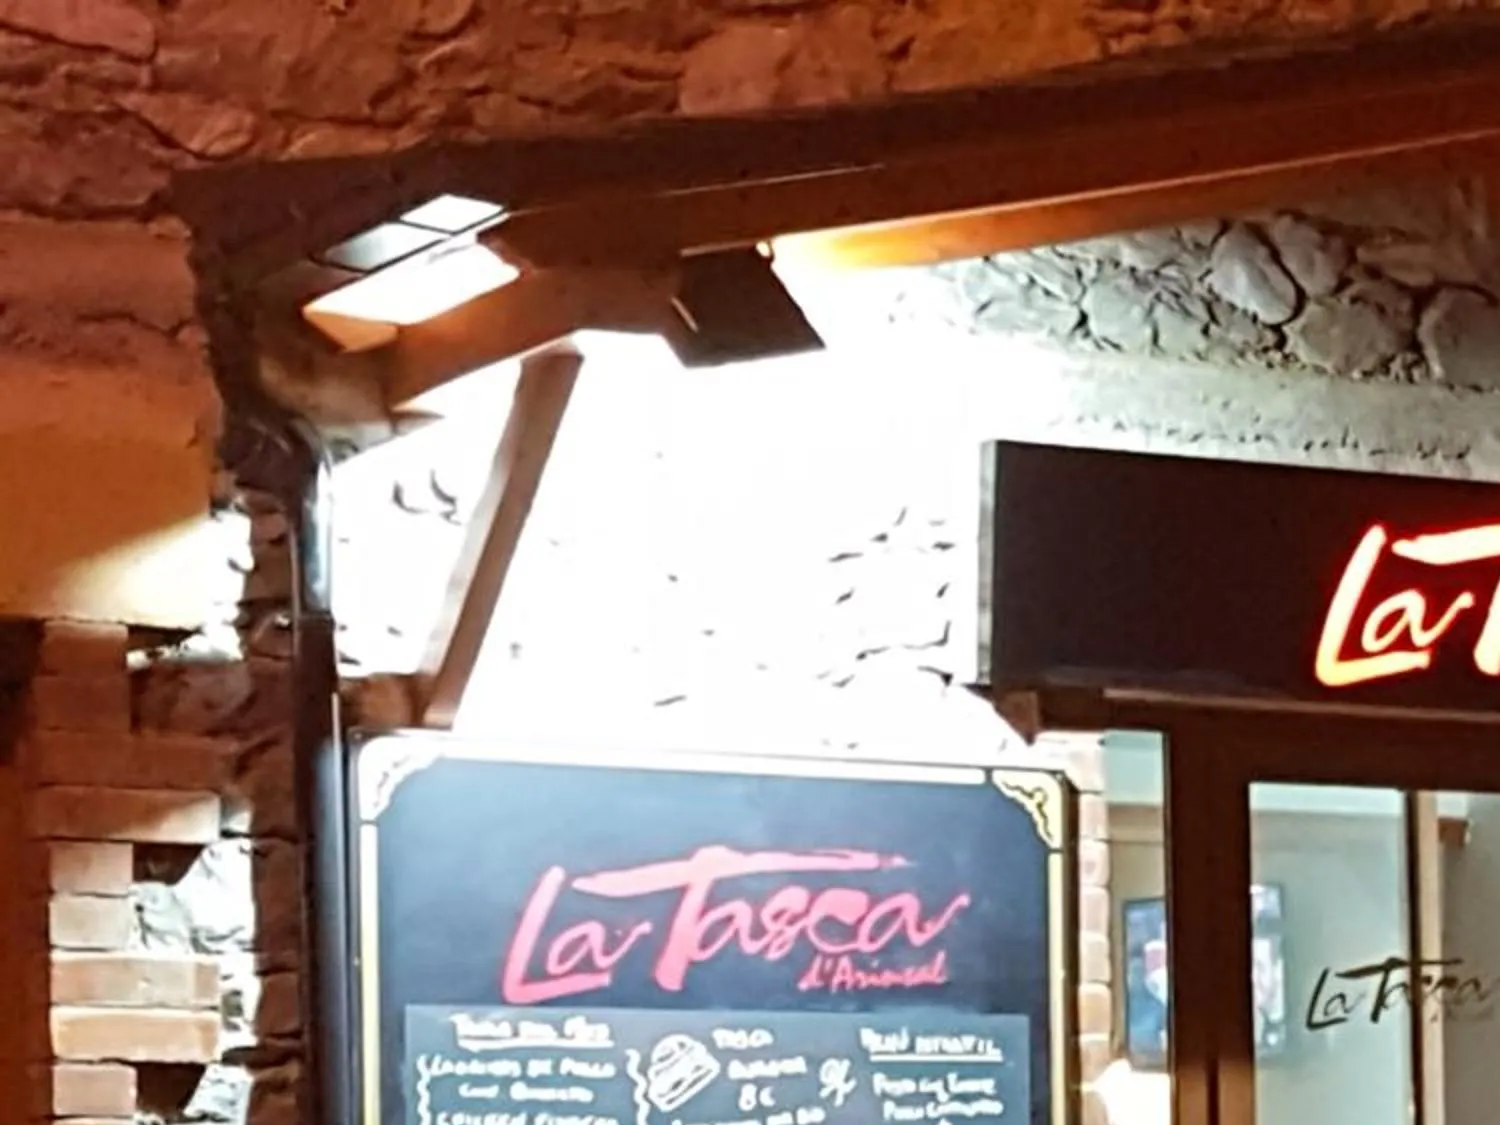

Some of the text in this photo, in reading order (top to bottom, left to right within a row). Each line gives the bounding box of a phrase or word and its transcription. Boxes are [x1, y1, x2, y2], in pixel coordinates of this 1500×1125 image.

[1315, 525, 1473, 686] La
[501, 845, 971, 1005] La Tasca
[1306, 967, 1367, 1030] La
